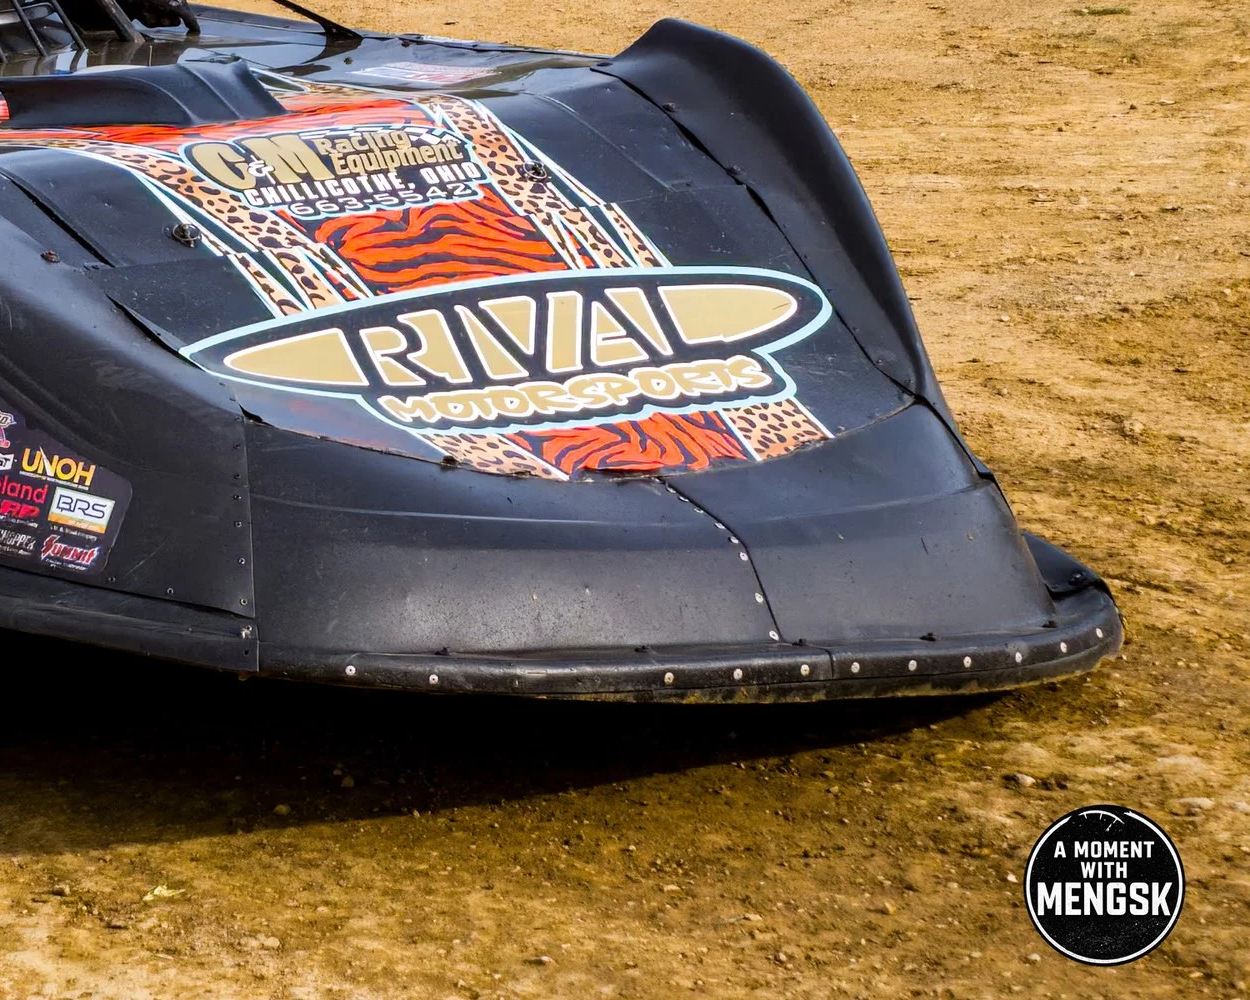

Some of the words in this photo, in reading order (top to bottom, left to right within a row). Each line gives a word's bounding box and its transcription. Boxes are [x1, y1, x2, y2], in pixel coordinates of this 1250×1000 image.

[313, 128, 412, 155] Racing
[331, 138, 464, 175] Equipment
[243, 171, 415, 206] CHILLICOTHE,
[420, 161, 481, 185] OHIO
[290, 184, 473, 216] 663-5542
[342, 282, 728, 388] RIVAL
[379, 355, 773, 422] MOTORSPORTS
[22, 446, 96, 486] UNOH
[56, 494, 107, 519] BRS
